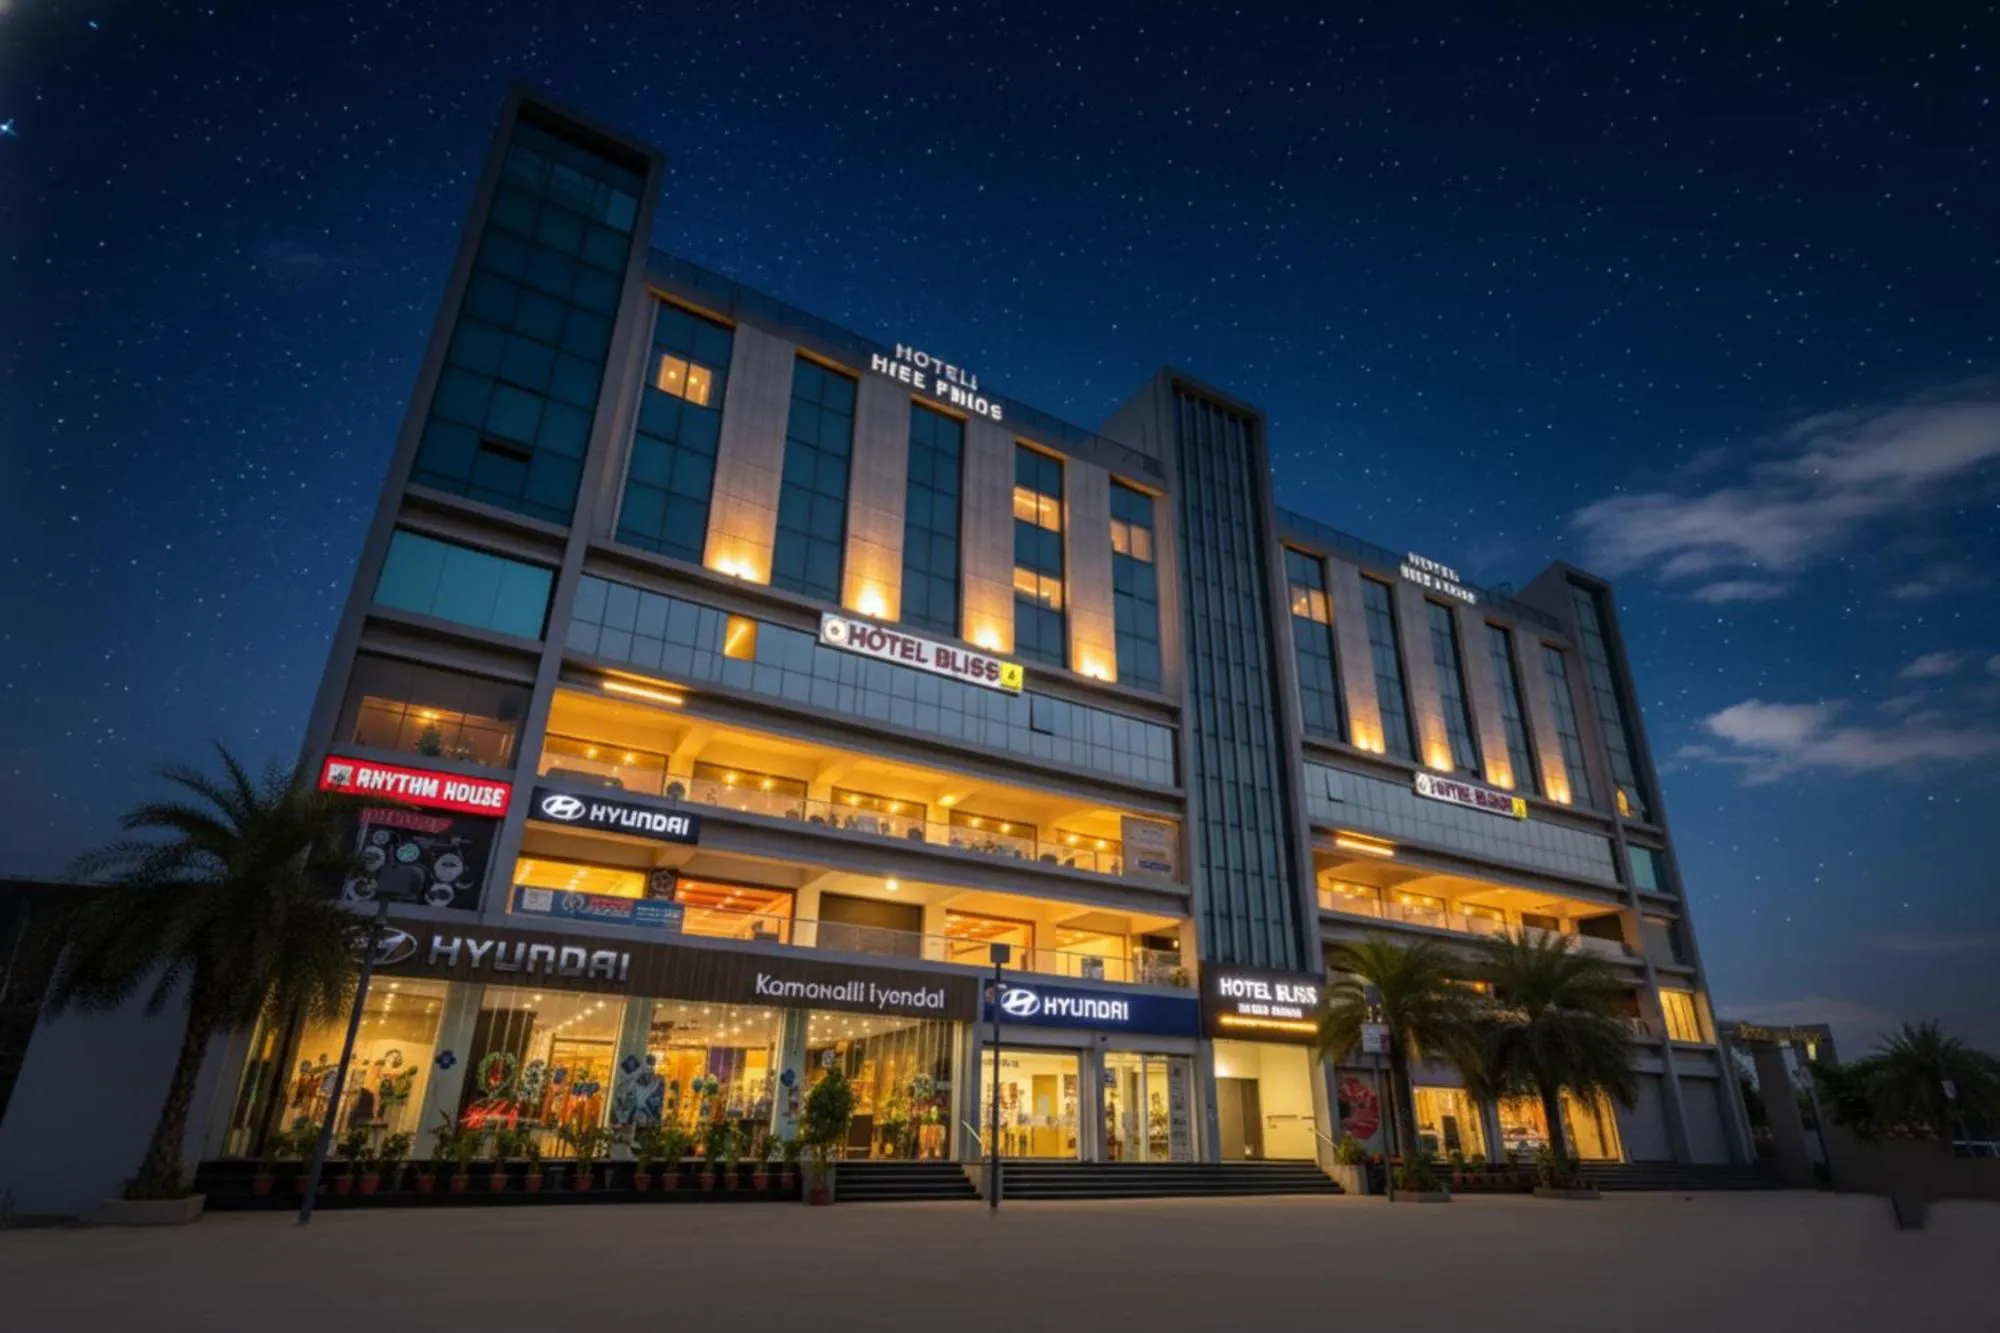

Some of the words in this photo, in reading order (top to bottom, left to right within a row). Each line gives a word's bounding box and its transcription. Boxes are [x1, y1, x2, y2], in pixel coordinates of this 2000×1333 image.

[848, 624, 928, 664] HOTEL
[935, 646, 999, 682] BLISS
[443, 781, 506, 808] HOUSE
[589, 803, 690, 836] HYUNDAI
[428, 934, 632, 982] HYUNDAI
[1219, 978, 1272, 1001] HOTEL
[1043, 996, 1130, 1021] HYUNDAI
